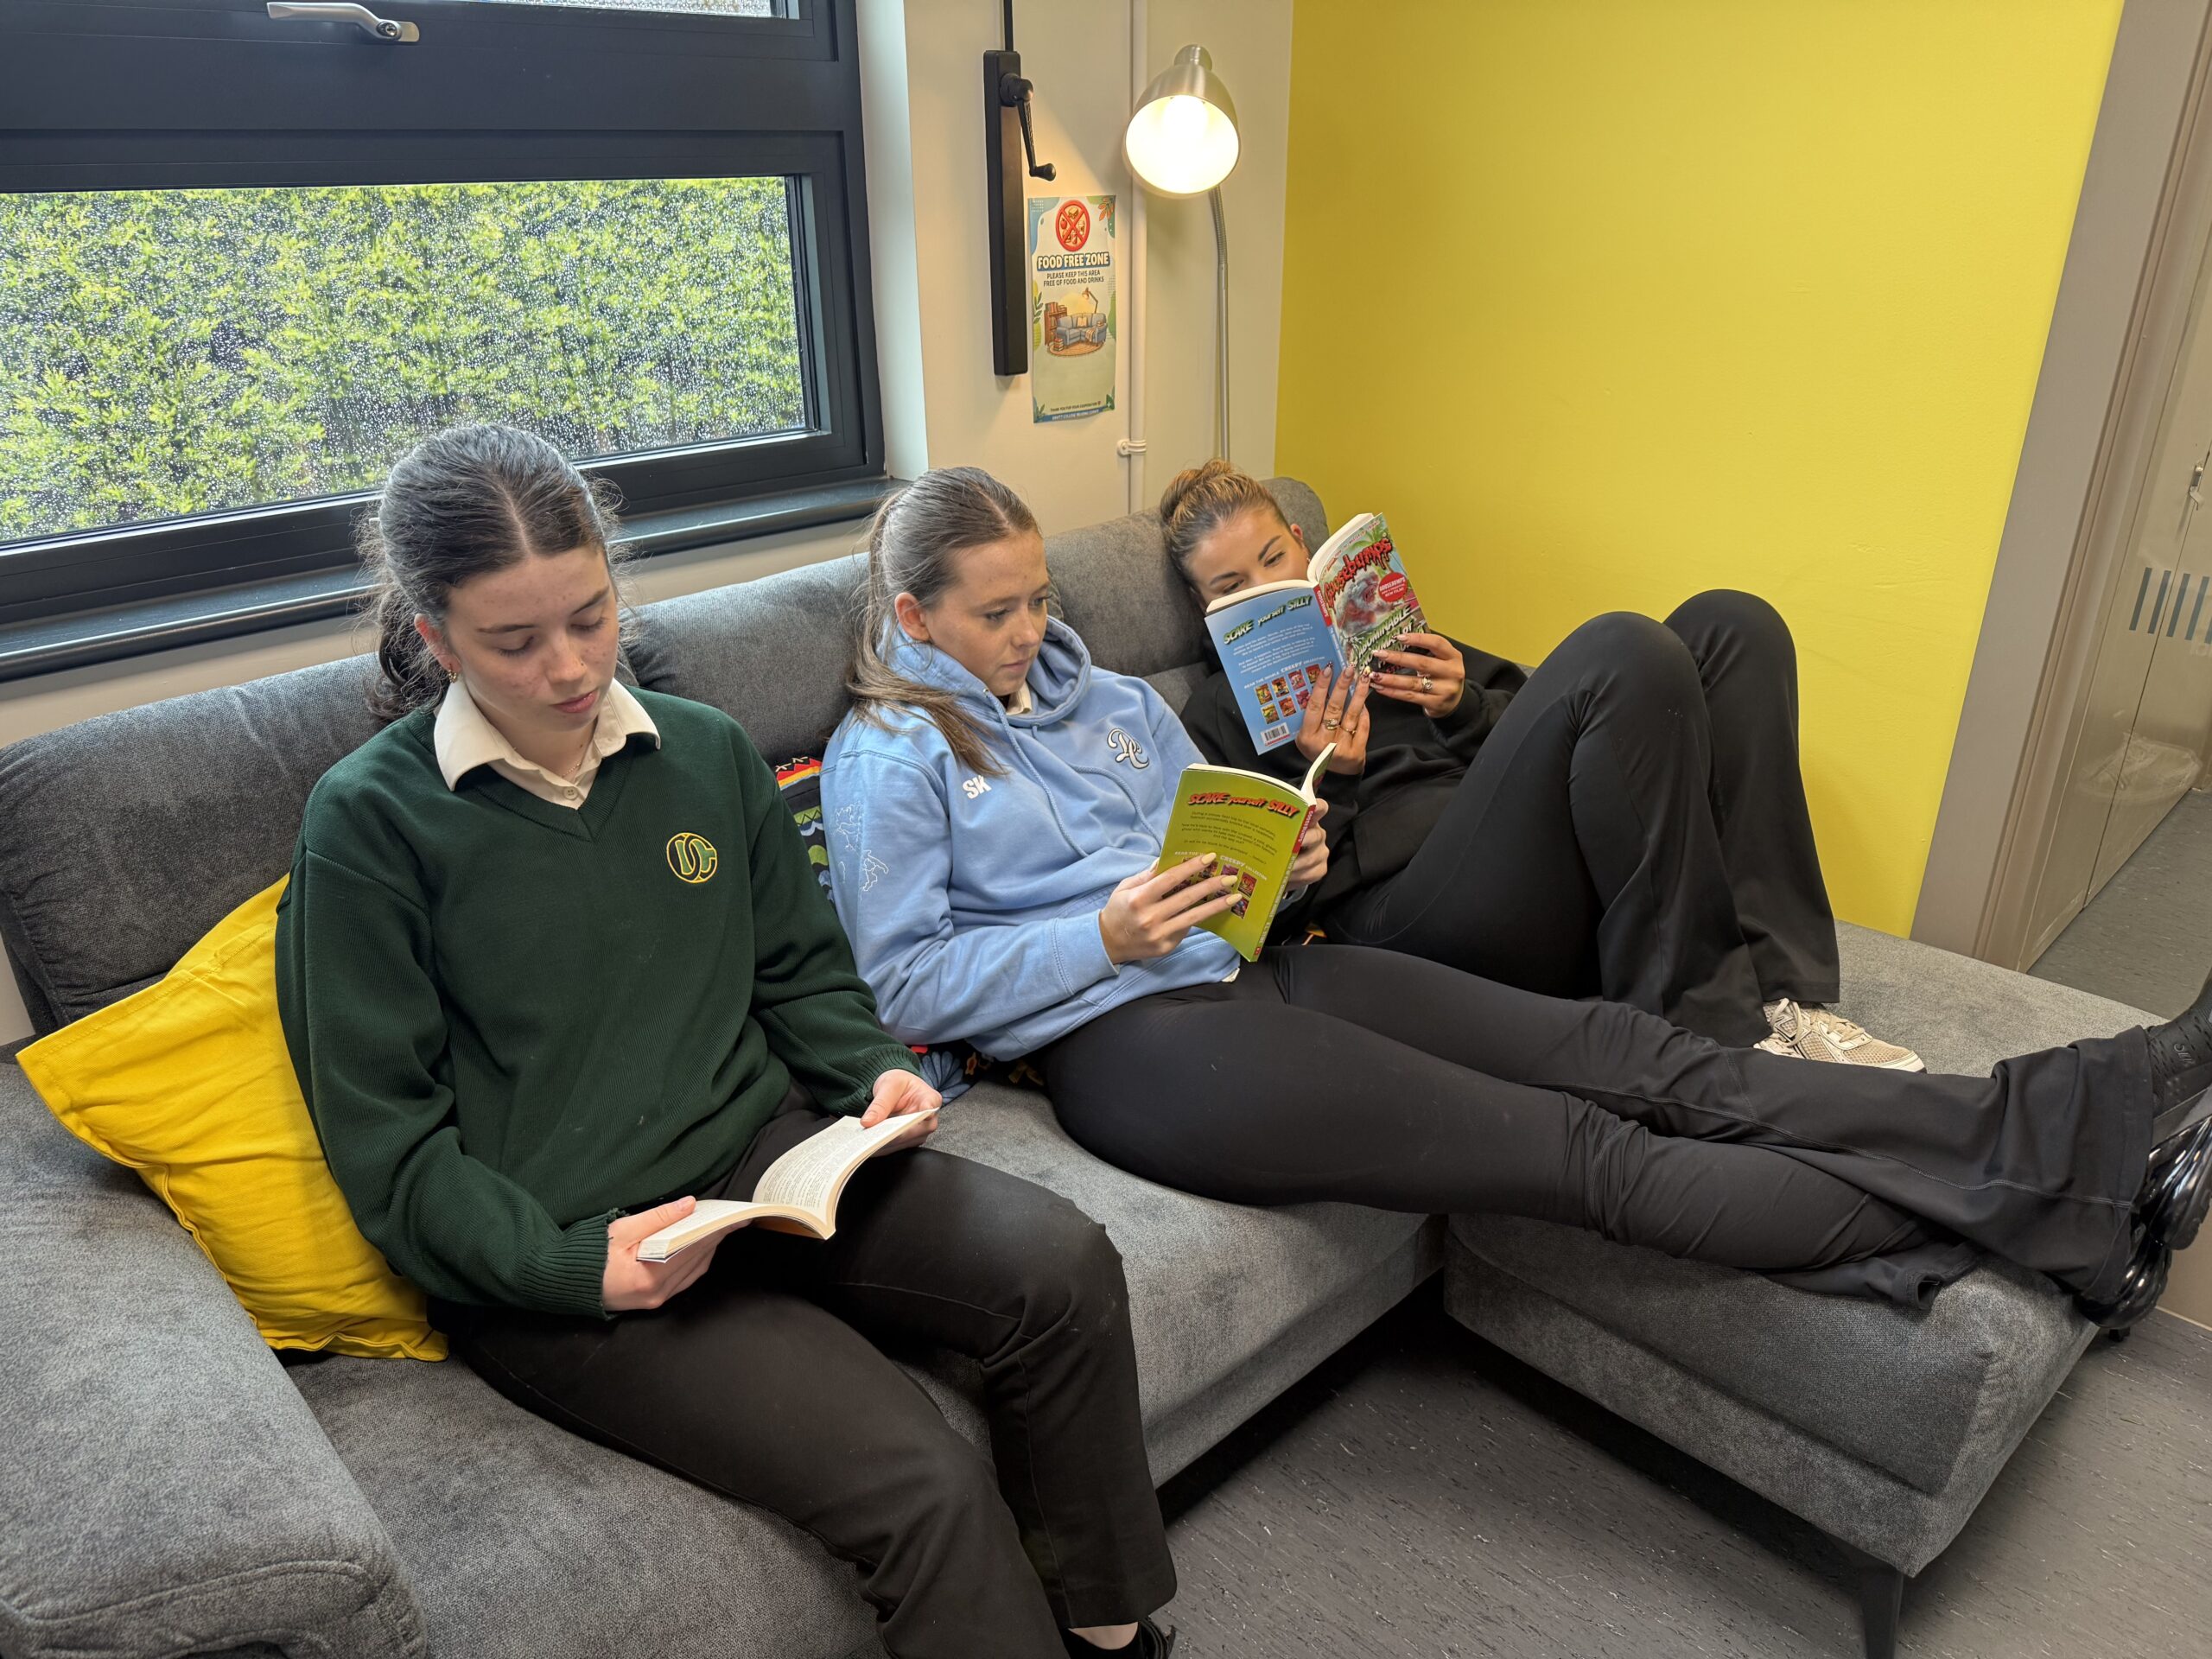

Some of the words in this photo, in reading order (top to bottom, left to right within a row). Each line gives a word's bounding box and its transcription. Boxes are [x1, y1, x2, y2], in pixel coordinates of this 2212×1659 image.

[1038, 256, 1063, 270] FOOD
[1064, 253, 1084, 268] FREE
[1085, 252, 1109, 266] ZONE
[1224, 619, 1254, 645] SCARE
[1287, 594, 1313, 611] SILLY
[963, 775, 992, 799] SK
[1188, 792, 1230, 805] SCARE
[1267, 799, 1300, 819] SILLY
